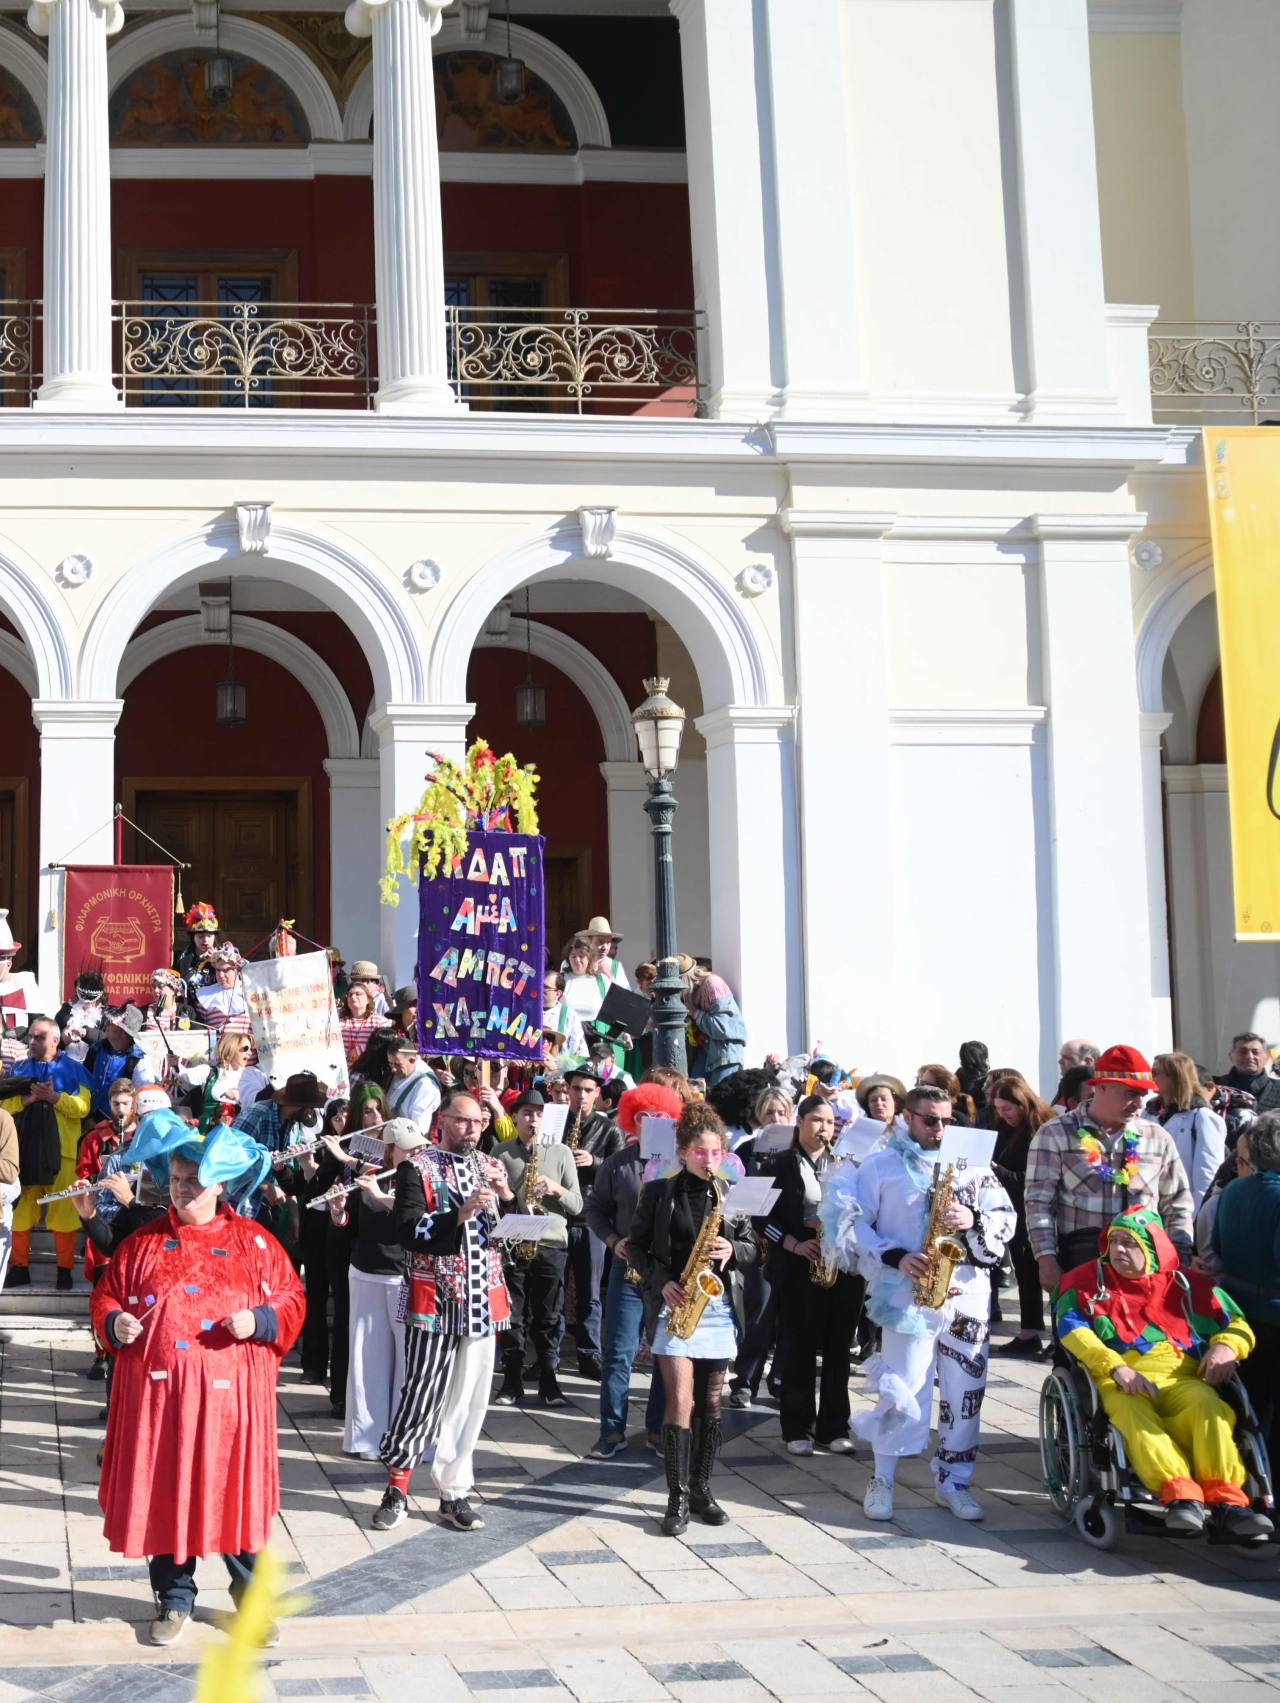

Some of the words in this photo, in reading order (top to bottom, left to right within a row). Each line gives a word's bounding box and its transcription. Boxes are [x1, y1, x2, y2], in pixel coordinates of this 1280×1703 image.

[74, 887, 127, 932] ΦΙΛΑΡΜΟΝΙΚΗ
[128, 889, 162, 934] ΟΡΧΗΣΤΡΑ
[102, 972, 155, 985] ΥΦΩΝΙΚΗ
[432, 996, 544, 1048] ΧΑΣΜΑΝ
